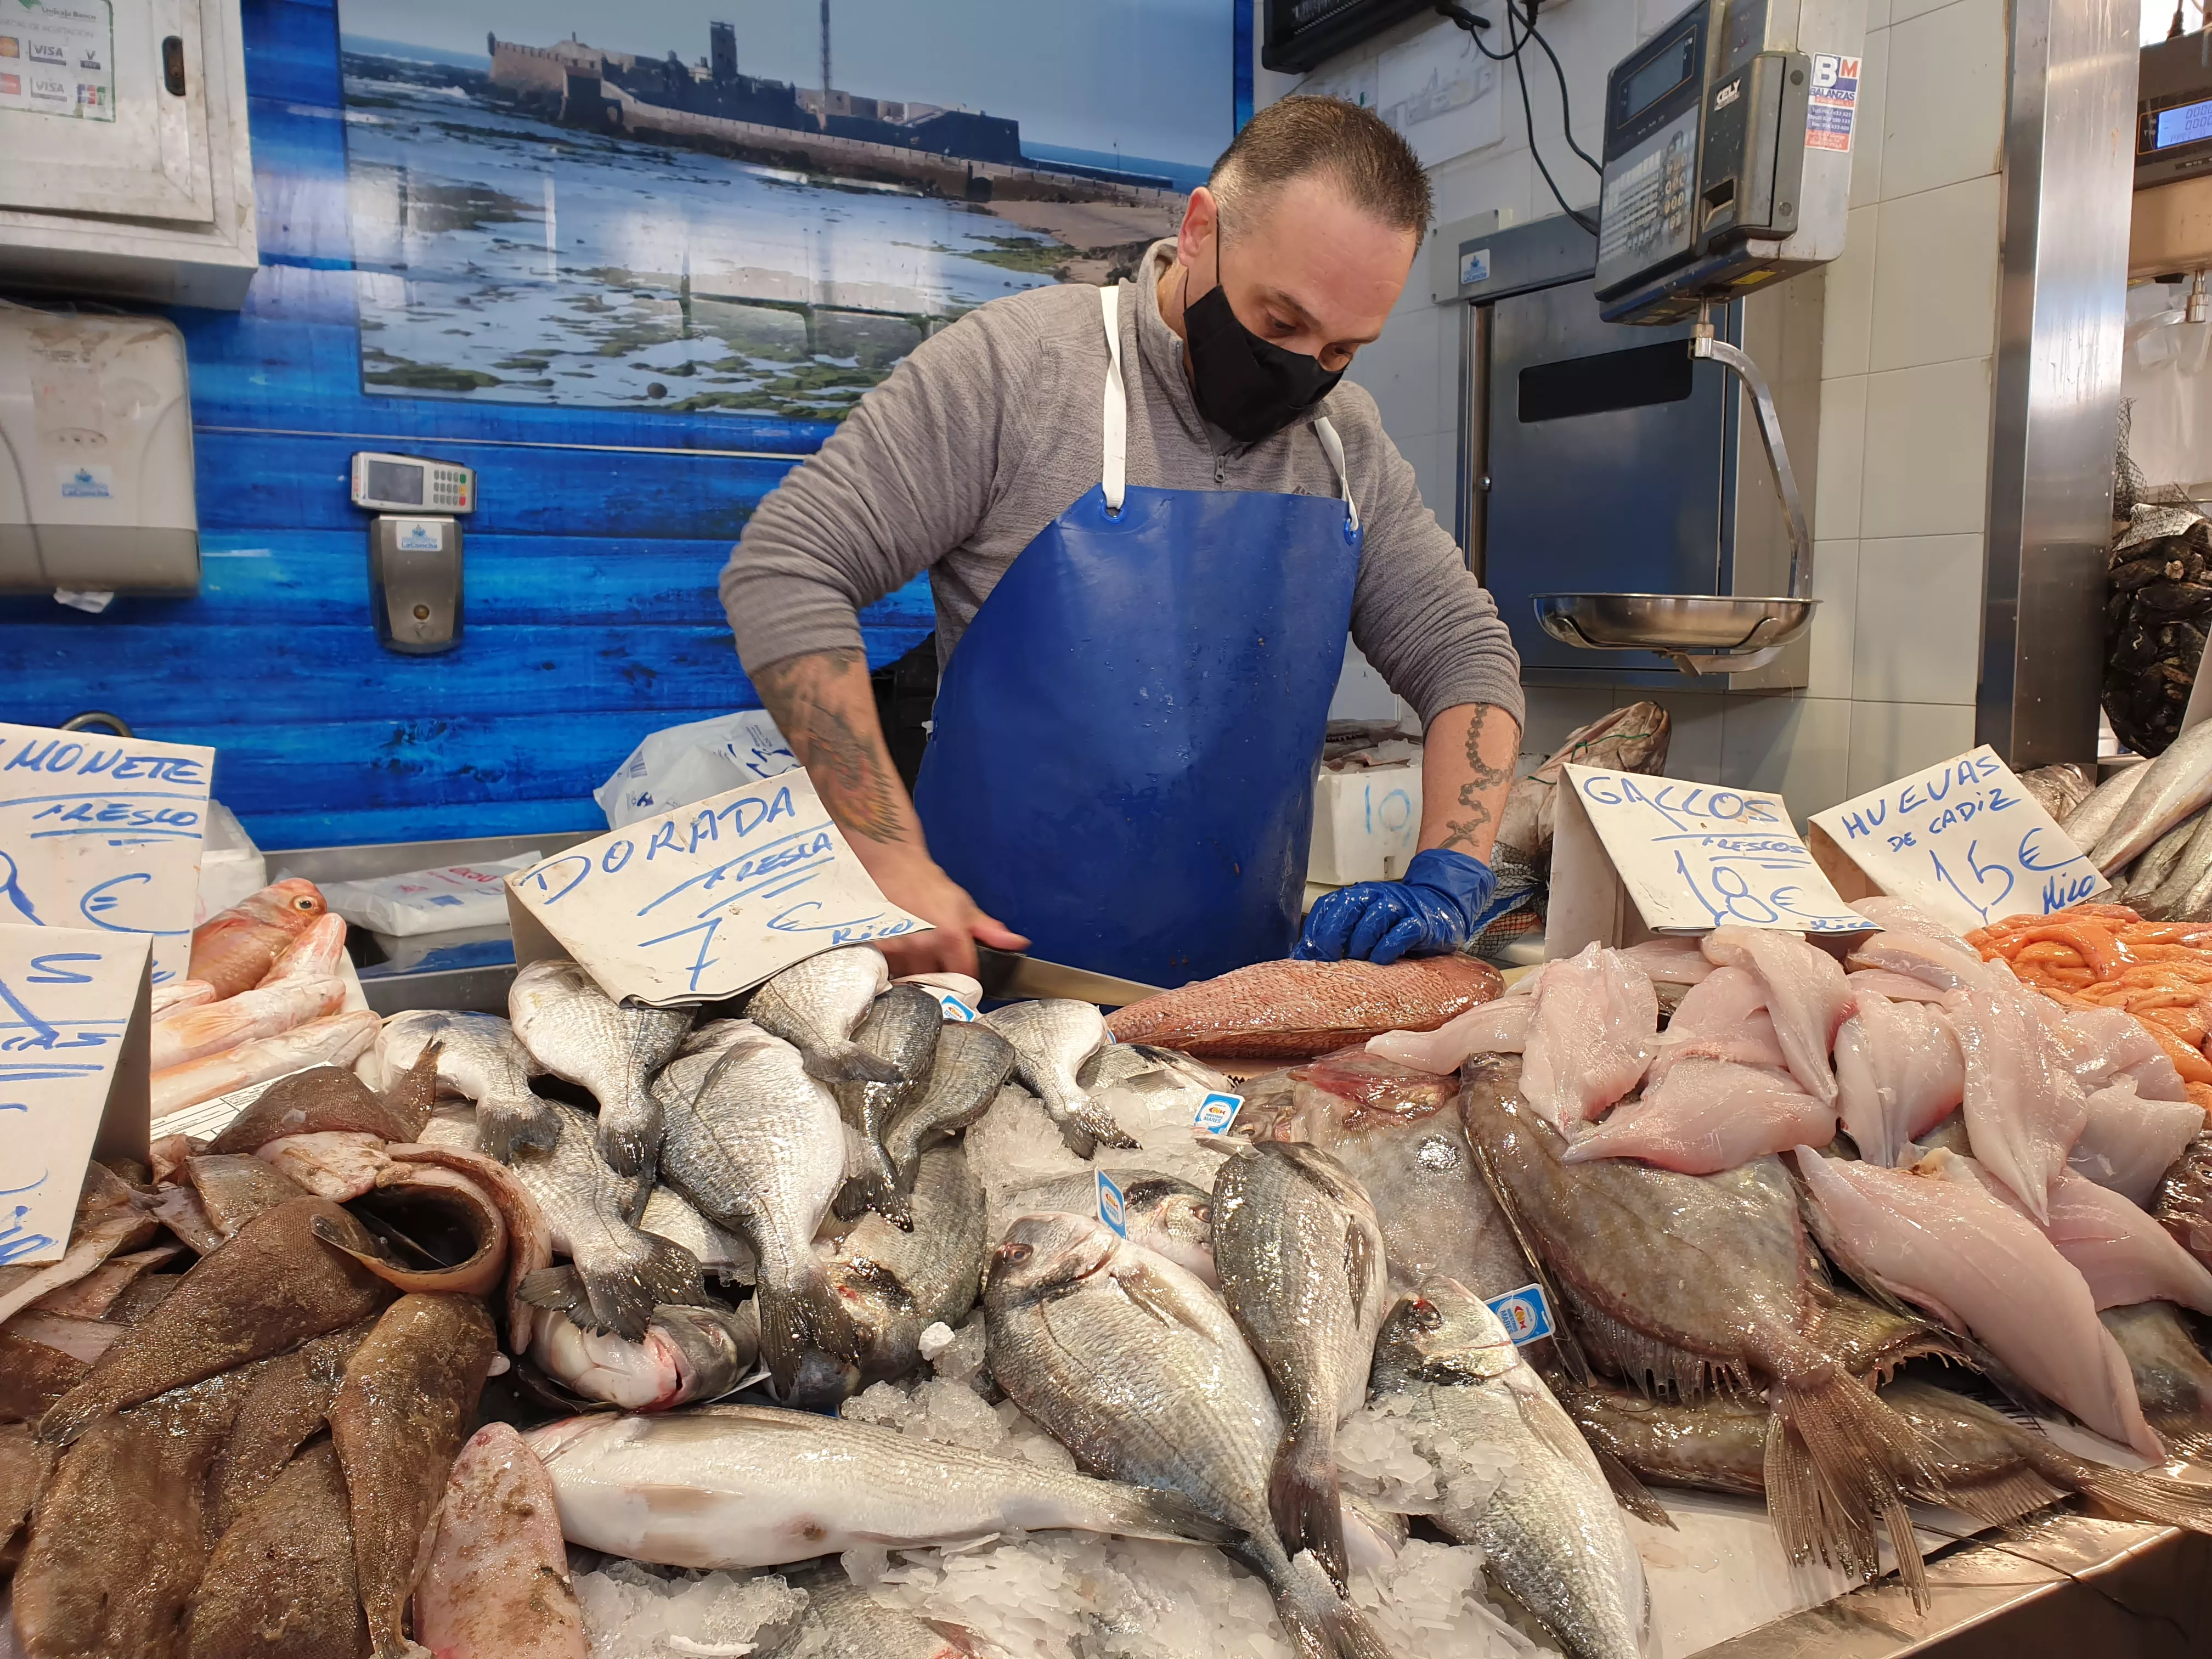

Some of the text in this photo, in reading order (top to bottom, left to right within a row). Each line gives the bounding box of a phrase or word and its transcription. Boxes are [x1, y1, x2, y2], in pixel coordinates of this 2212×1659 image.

[73, 11, 97, 20] Banco
[34, 44, 64, 58] VISA
[36, 81, 65, 93] VISA
[1810, 88, 1855, 100] BALANZAS
[0, 738, 206, 785] MONETE
[1583, 776, 1780, 832] GALLOS
[1841, 755, 2001, 839] HUEVAS
[519, 786, 795, 905] DORADA
[1886, 831, 1917, 853] DE
[637, 917, 723, 991] 7
[1500, 1310, 1514, 1334] MARES
